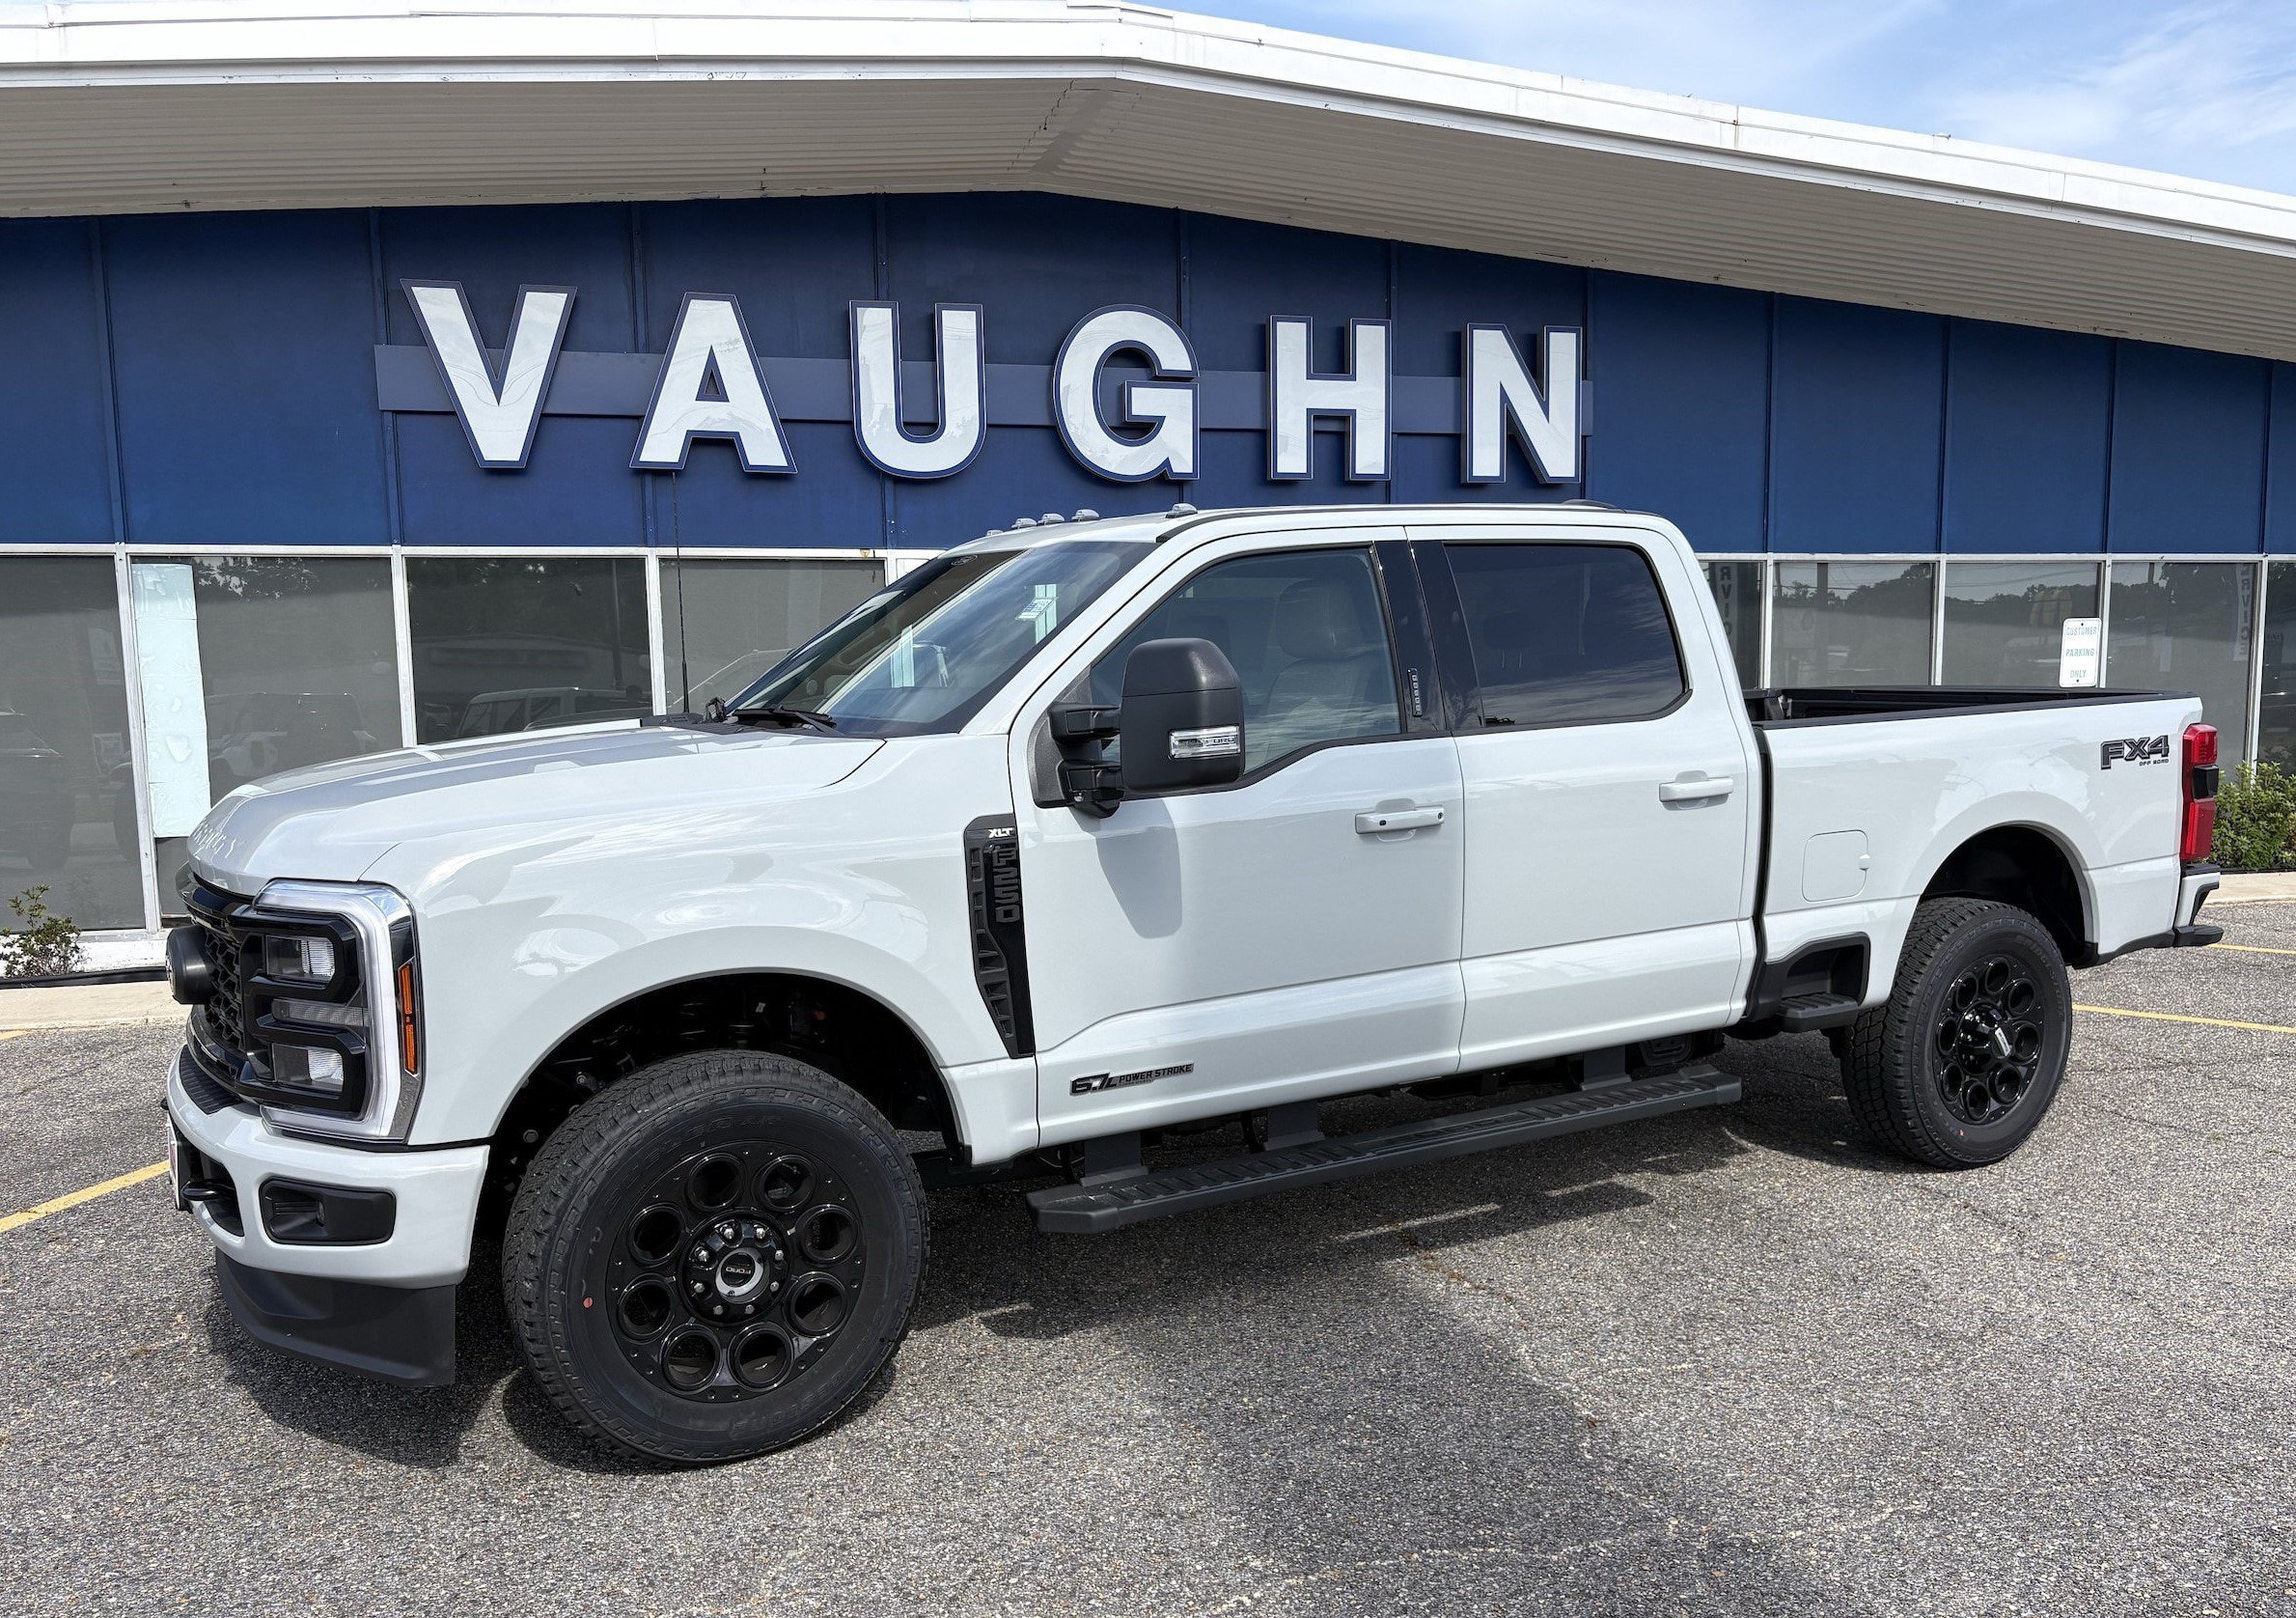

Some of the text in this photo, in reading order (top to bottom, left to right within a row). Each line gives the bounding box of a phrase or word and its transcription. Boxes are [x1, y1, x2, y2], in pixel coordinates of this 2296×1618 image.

[401, 279, 1583, 484] VAUGHN
[2066, 627, 2097, 636] CUSTOMER
[2065, 648, 2094, 657] PARKING
[2101, 735, 2170, 769] FX4
[988, 827, 1014, 838] XLT
[1071, 1073, 1118, 1093] 6.7L
[1120, 1070, 1152, 1083] POWER
[1154, 1063, 1194, 1077] STROKE
